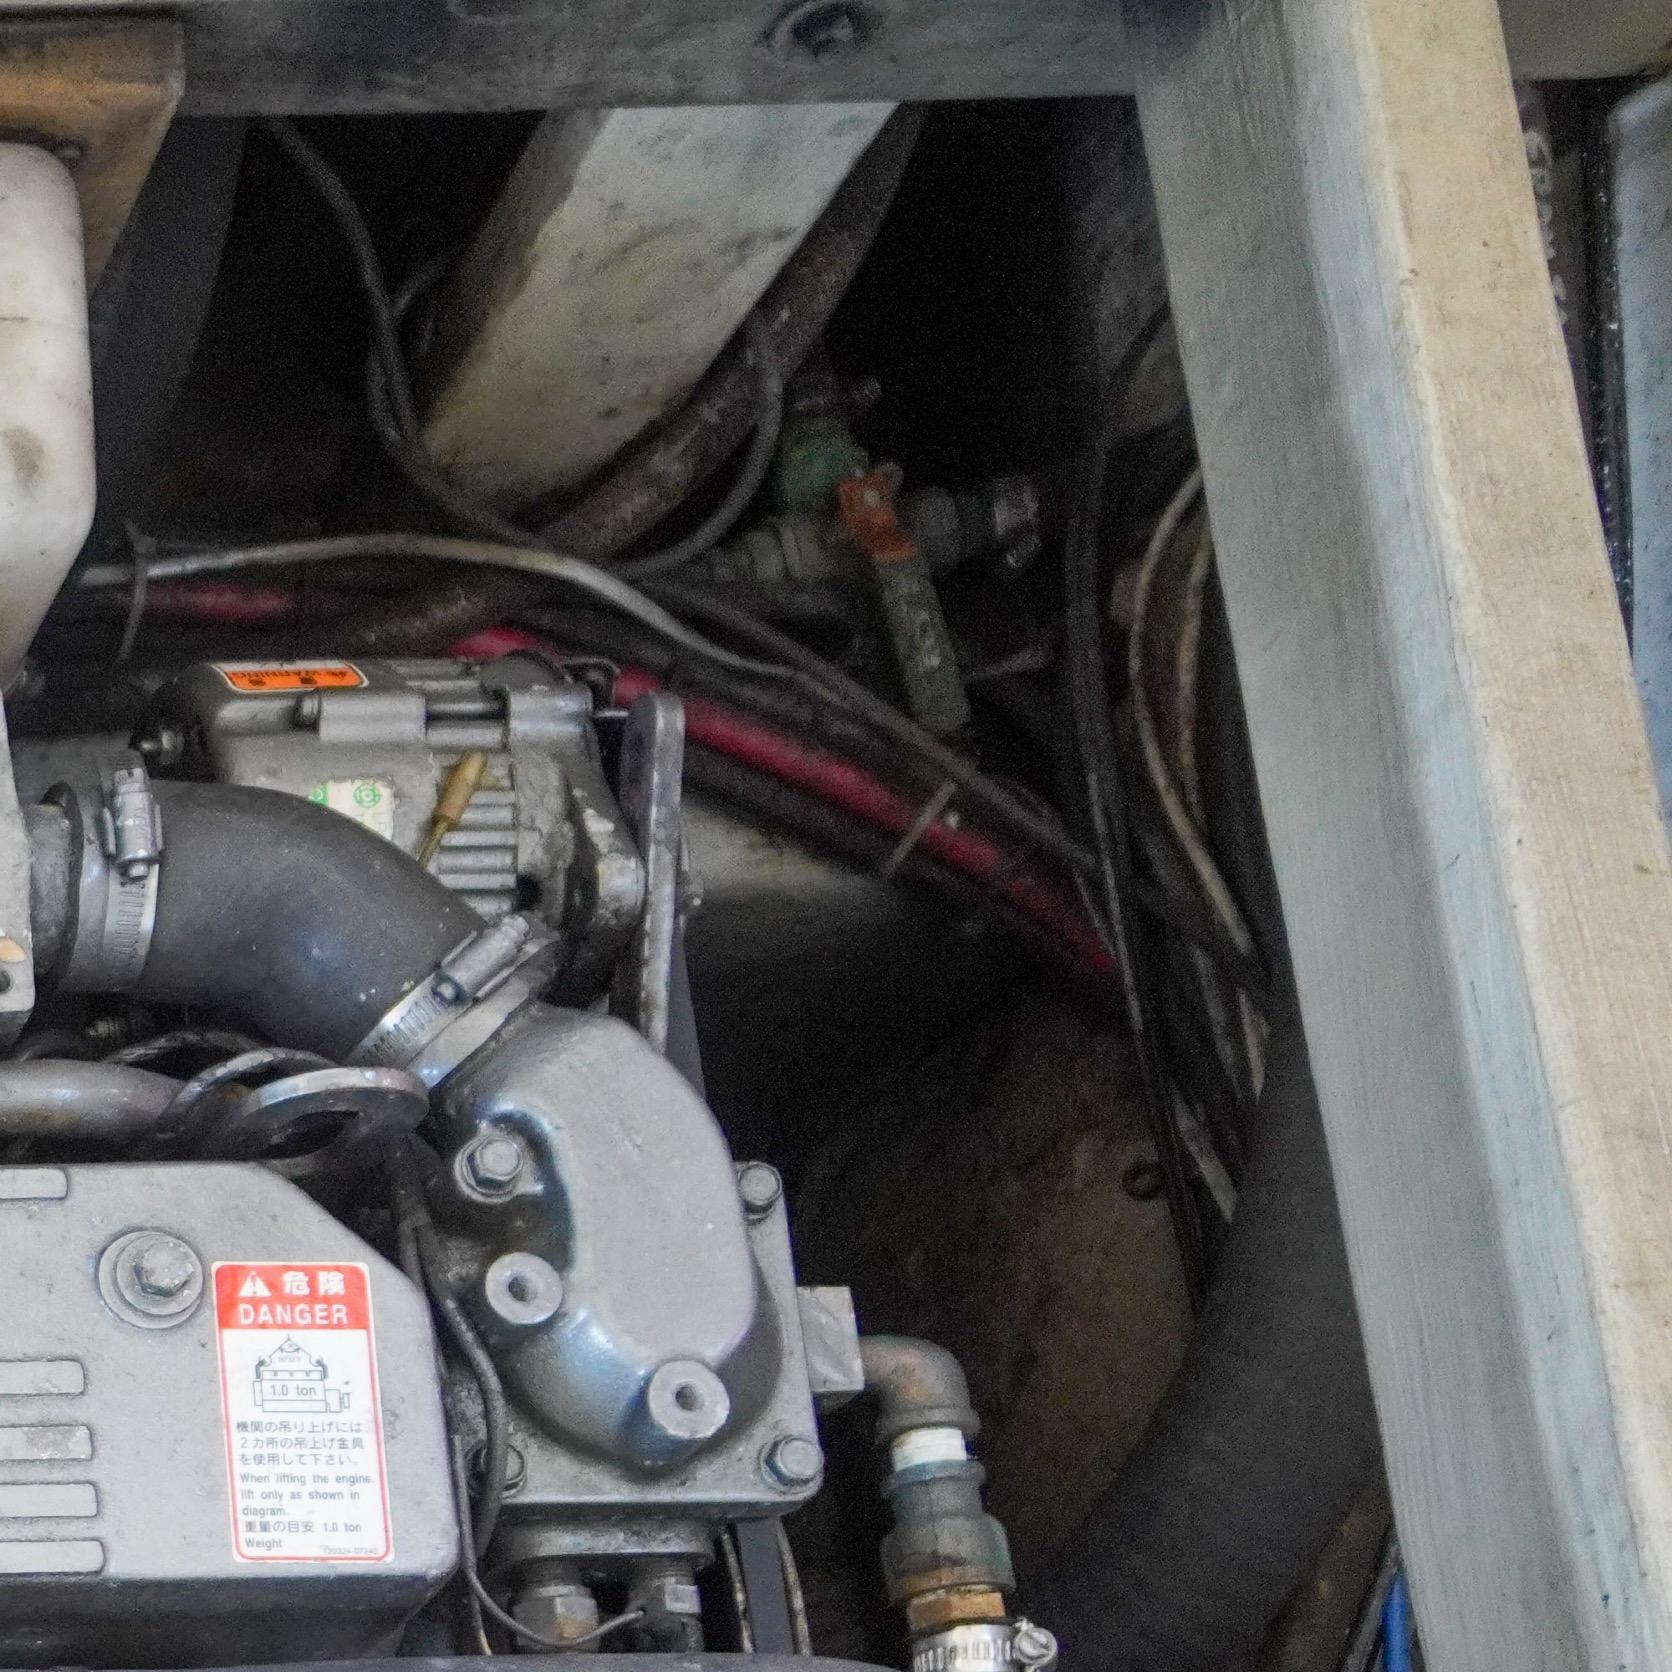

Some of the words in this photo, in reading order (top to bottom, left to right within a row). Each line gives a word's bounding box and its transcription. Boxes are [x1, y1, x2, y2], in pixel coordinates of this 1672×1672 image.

[282, 1270, 346, 1296] 危険
[239, 1303, 348, 1325] DANGER
[271, 1384, 289, 1396] 1.0
[296, 1384, 317, 1396] ton
[239, 1473, 270, 1483] When
[276, 1472, 306, 1485] lifting
[313, 1473, 329, 1484] the
[240, 1489, 254, 1500] lift
[261, 1489, 283, 1501] only
[290, 1491, 302, 1500] as
[308, 1489, 344, 1500] shown
[350, 1489, 360, 1500] in
[323, 1522, 338, 1532] 1.0
[344, 1522, 362, 1532] ton
[245, 1538, 282, 1551] Weight
